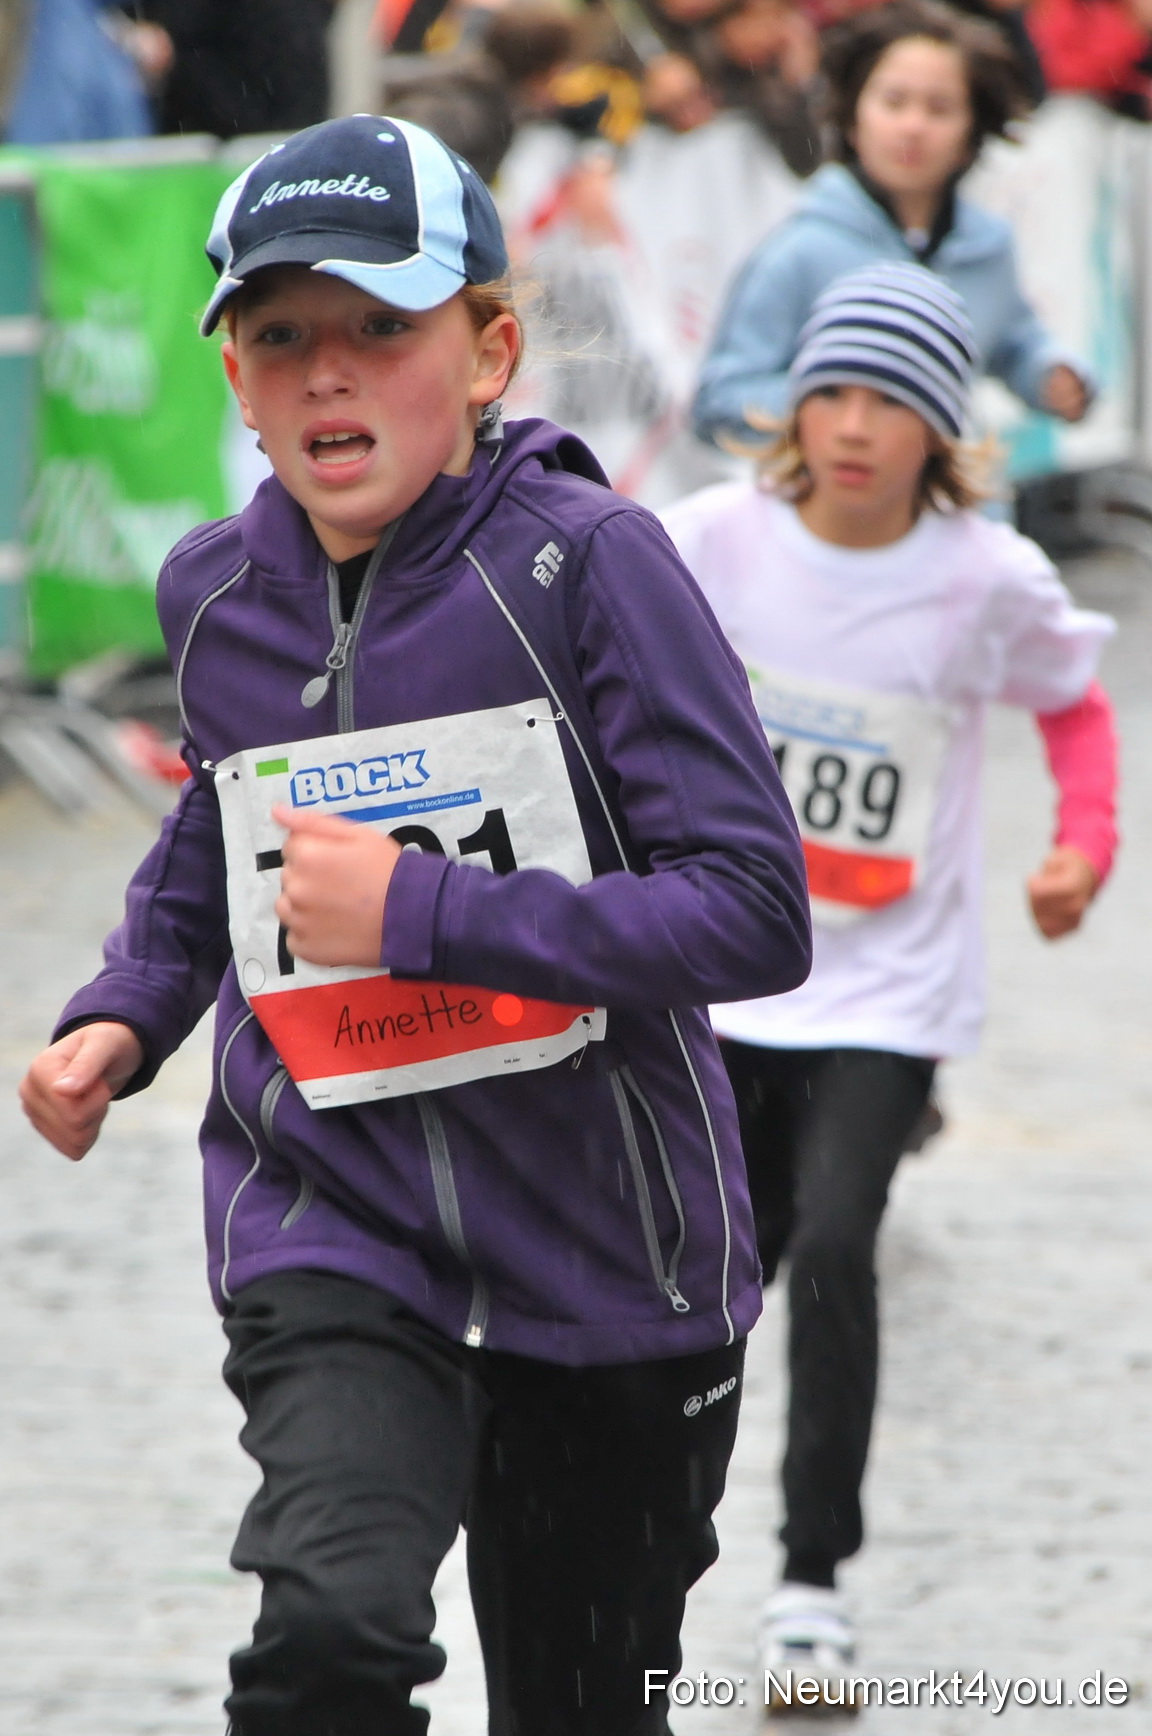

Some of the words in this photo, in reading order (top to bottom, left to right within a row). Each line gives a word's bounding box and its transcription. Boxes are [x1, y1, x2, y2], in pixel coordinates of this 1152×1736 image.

[249, 174, 391, 213] Annette
[290, 749, 431, 808] BOCK
[406, 792, 475, 811] www.bockonline.de
[334, 990, 483, 1048] Annette
[704, 1376, 737, 1407] JAKO
